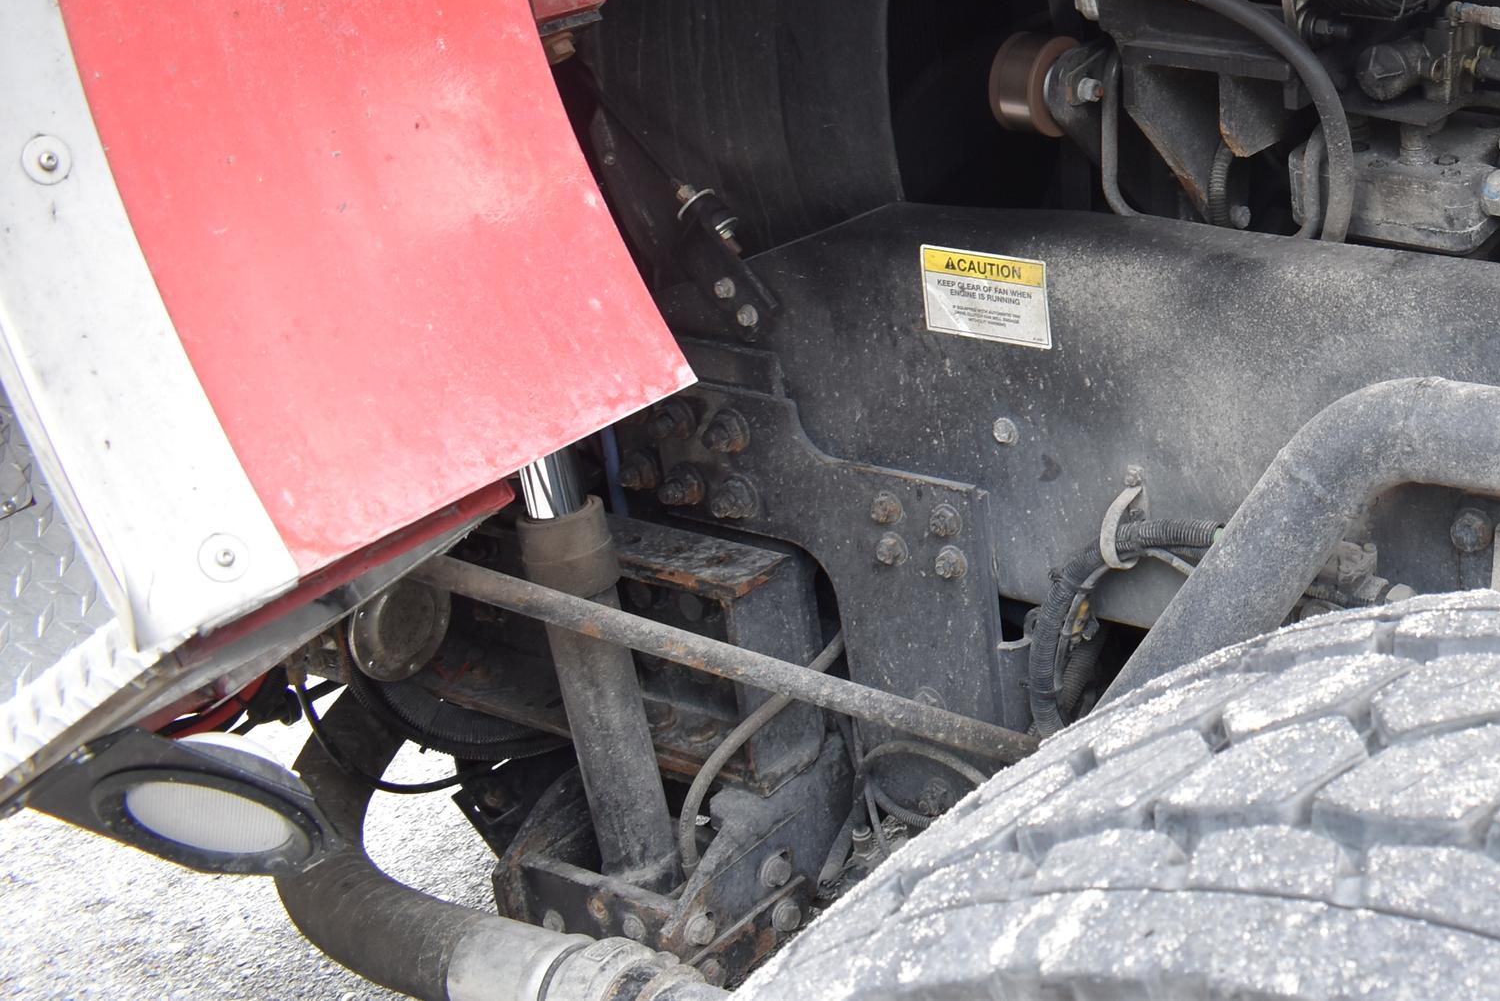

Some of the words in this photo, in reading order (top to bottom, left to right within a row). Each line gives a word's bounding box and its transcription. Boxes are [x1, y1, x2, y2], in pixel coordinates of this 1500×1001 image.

[957, 258, 1022, 280] CAUTION
[937, 279, 956, 288] KEEP
[958, 281, 982, 291] CLEAR
[982, 285, 993, 293] OF
[995, 287, 1009, 296] FAN
[1010, 288, 1032, 299] WHEN
[950, 289, 977, 300] ENGINE
[978, 292, 985, 301] IS
[986, 293, 1020, 306] RUNNING
